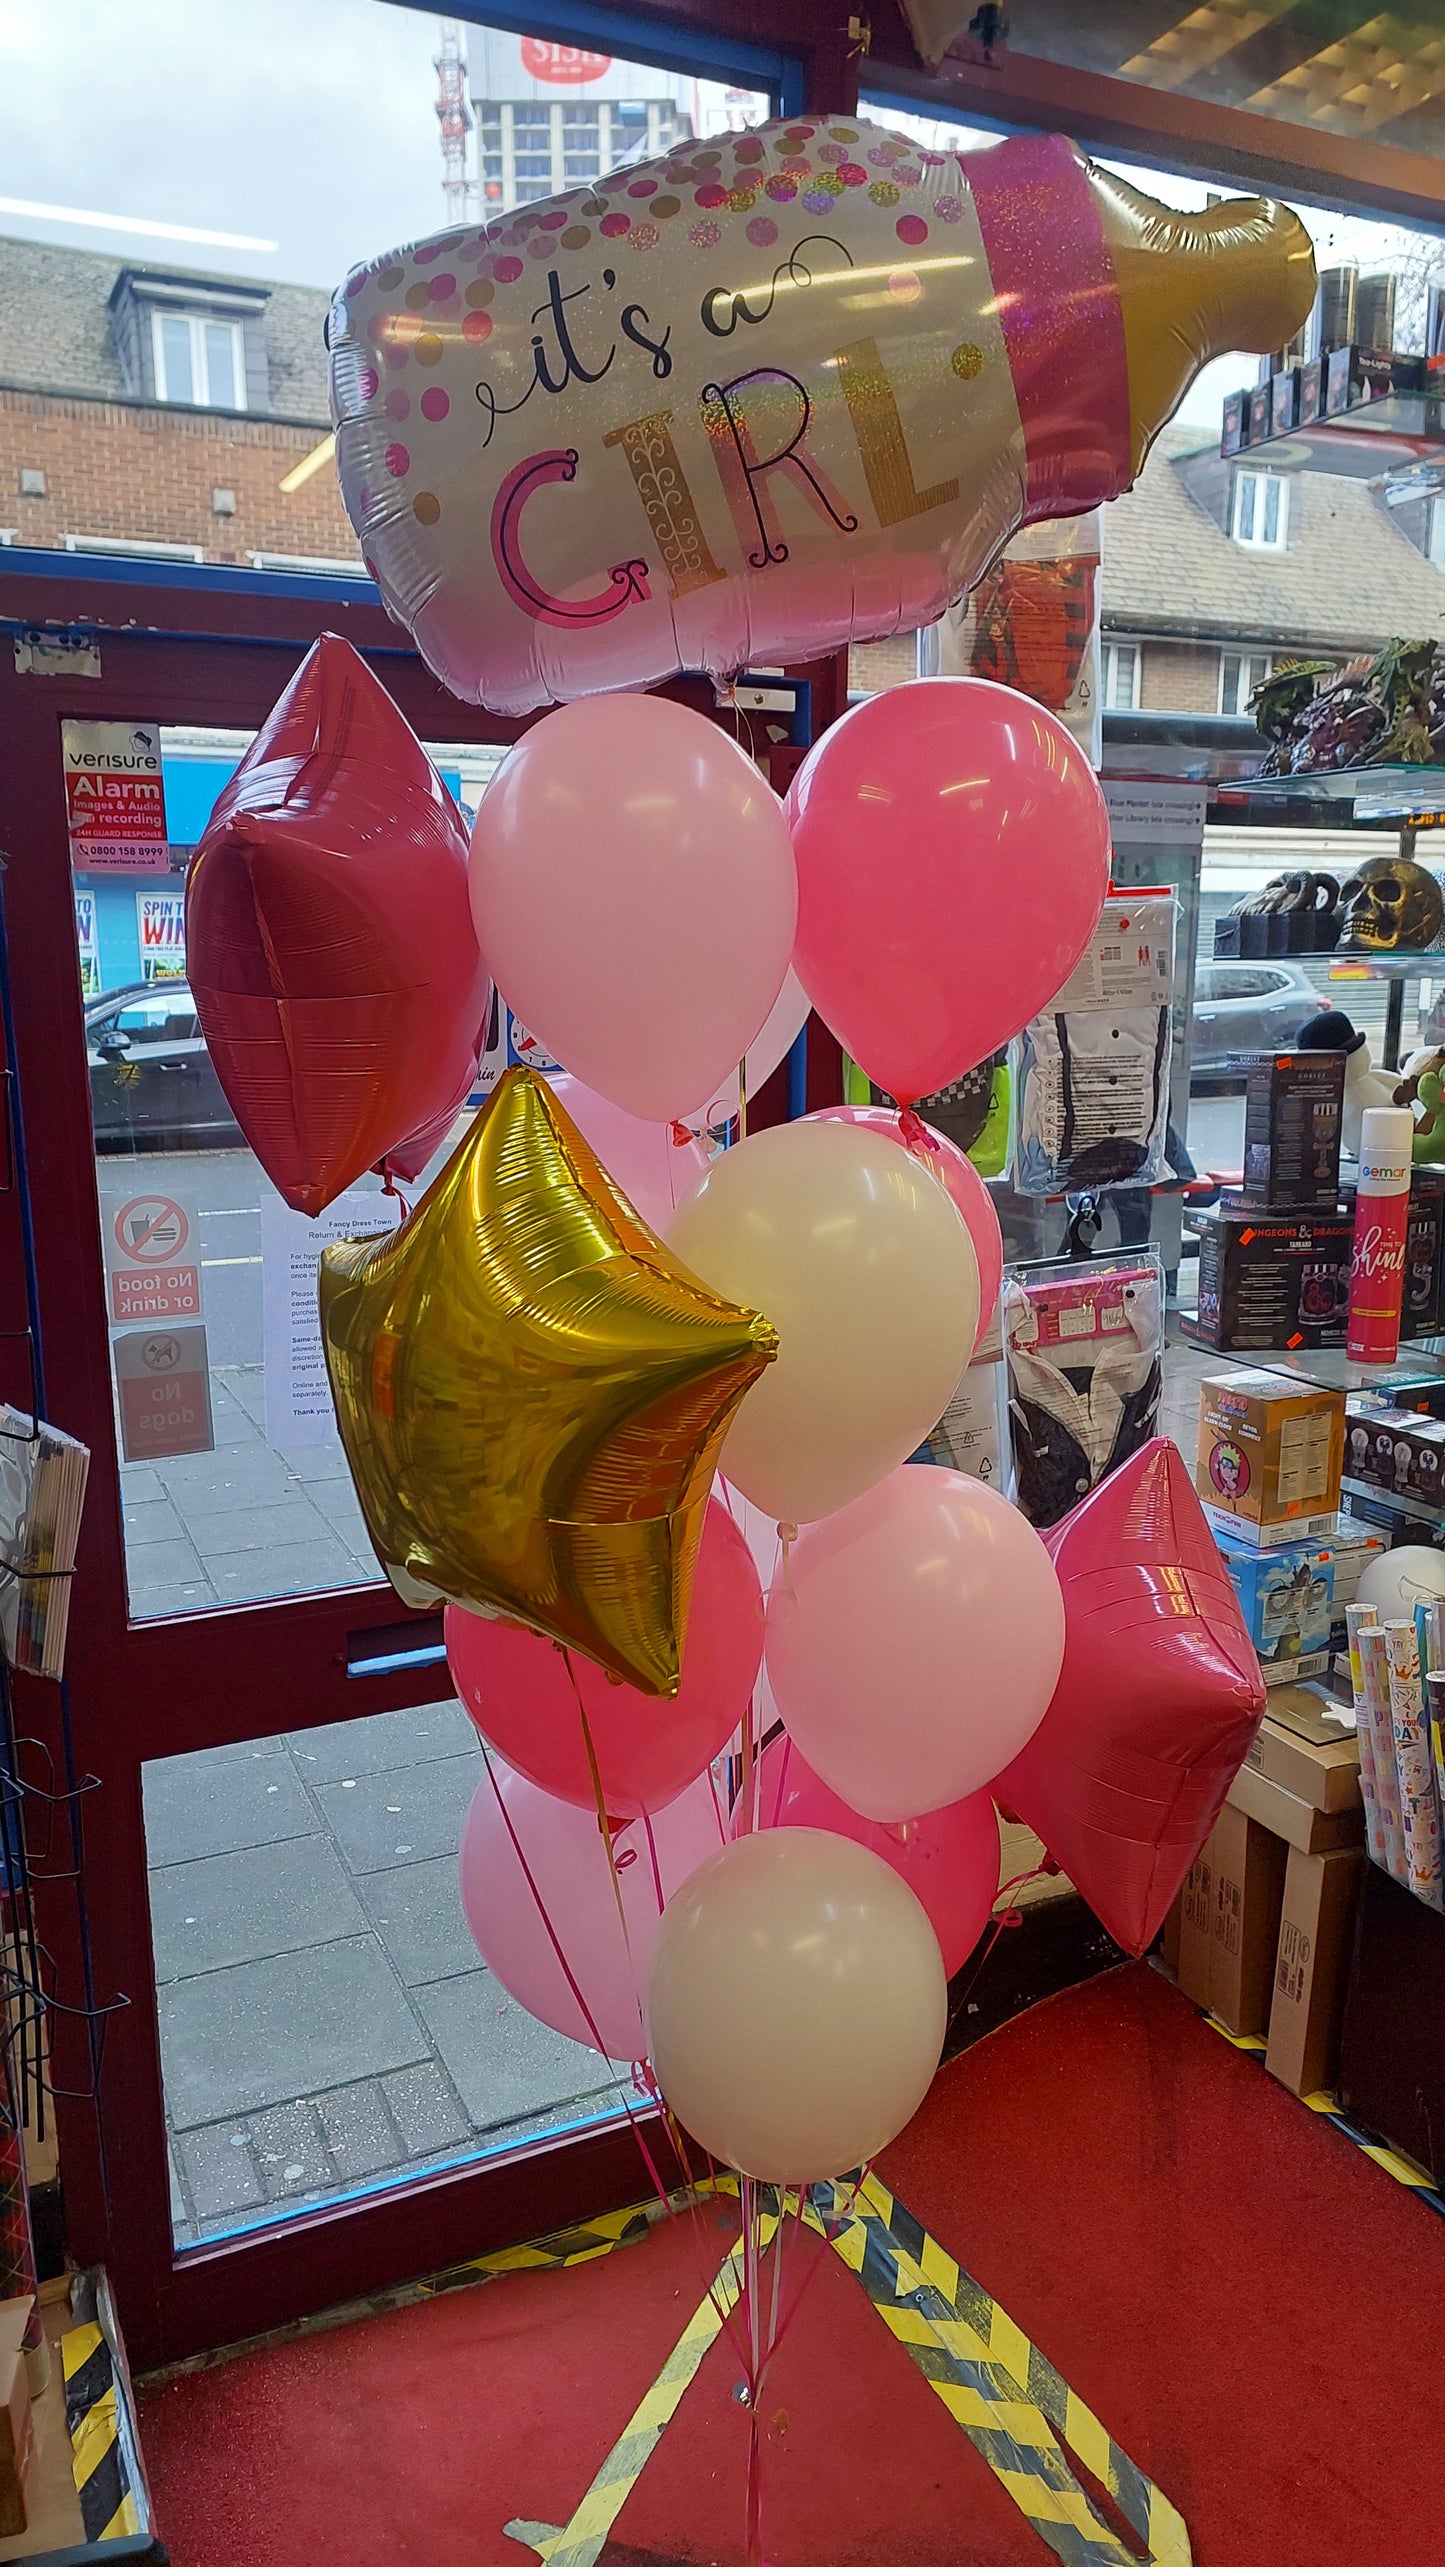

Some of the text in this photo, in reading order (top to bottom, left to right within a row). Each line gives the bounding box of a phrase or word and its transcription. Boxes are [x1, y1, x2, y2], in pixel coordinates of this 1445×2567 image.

[475, 235, 854, 447] it's a
[490, 335, 960, 629] GIRL
[69, 753, 158, 769] verisure
[73, 775, 160, 799] Alarm
[73, 800, 161, 811] Images & Audio
[99, 812, 162, 827] recording
[76, 829, 163, 838] 24H GUARD RESPONSE
[90, 846, 163, 857] 0800 158 8999
[88, 857, 156, 865] www.verisure.co.uk
[143, 901, 184, 916] SPIN T
[143, 917, 185, 945] WIN
[1362, 1166, 1407, 1178] Gemar
[328, 1220, 350, 1229] Fancy
[352, 1219, 372, 1227] Dress
[308, 1231, 335, 1239] Return
[1252, 1228, 1297, 1237] NGEONS
[1298, 1225, 1313, 1239] &
[291, 1317, 319, 1325] satisfied
[291, 1344, 317, 1352] allowed
[293, 1408, 315, 1416] Thank
